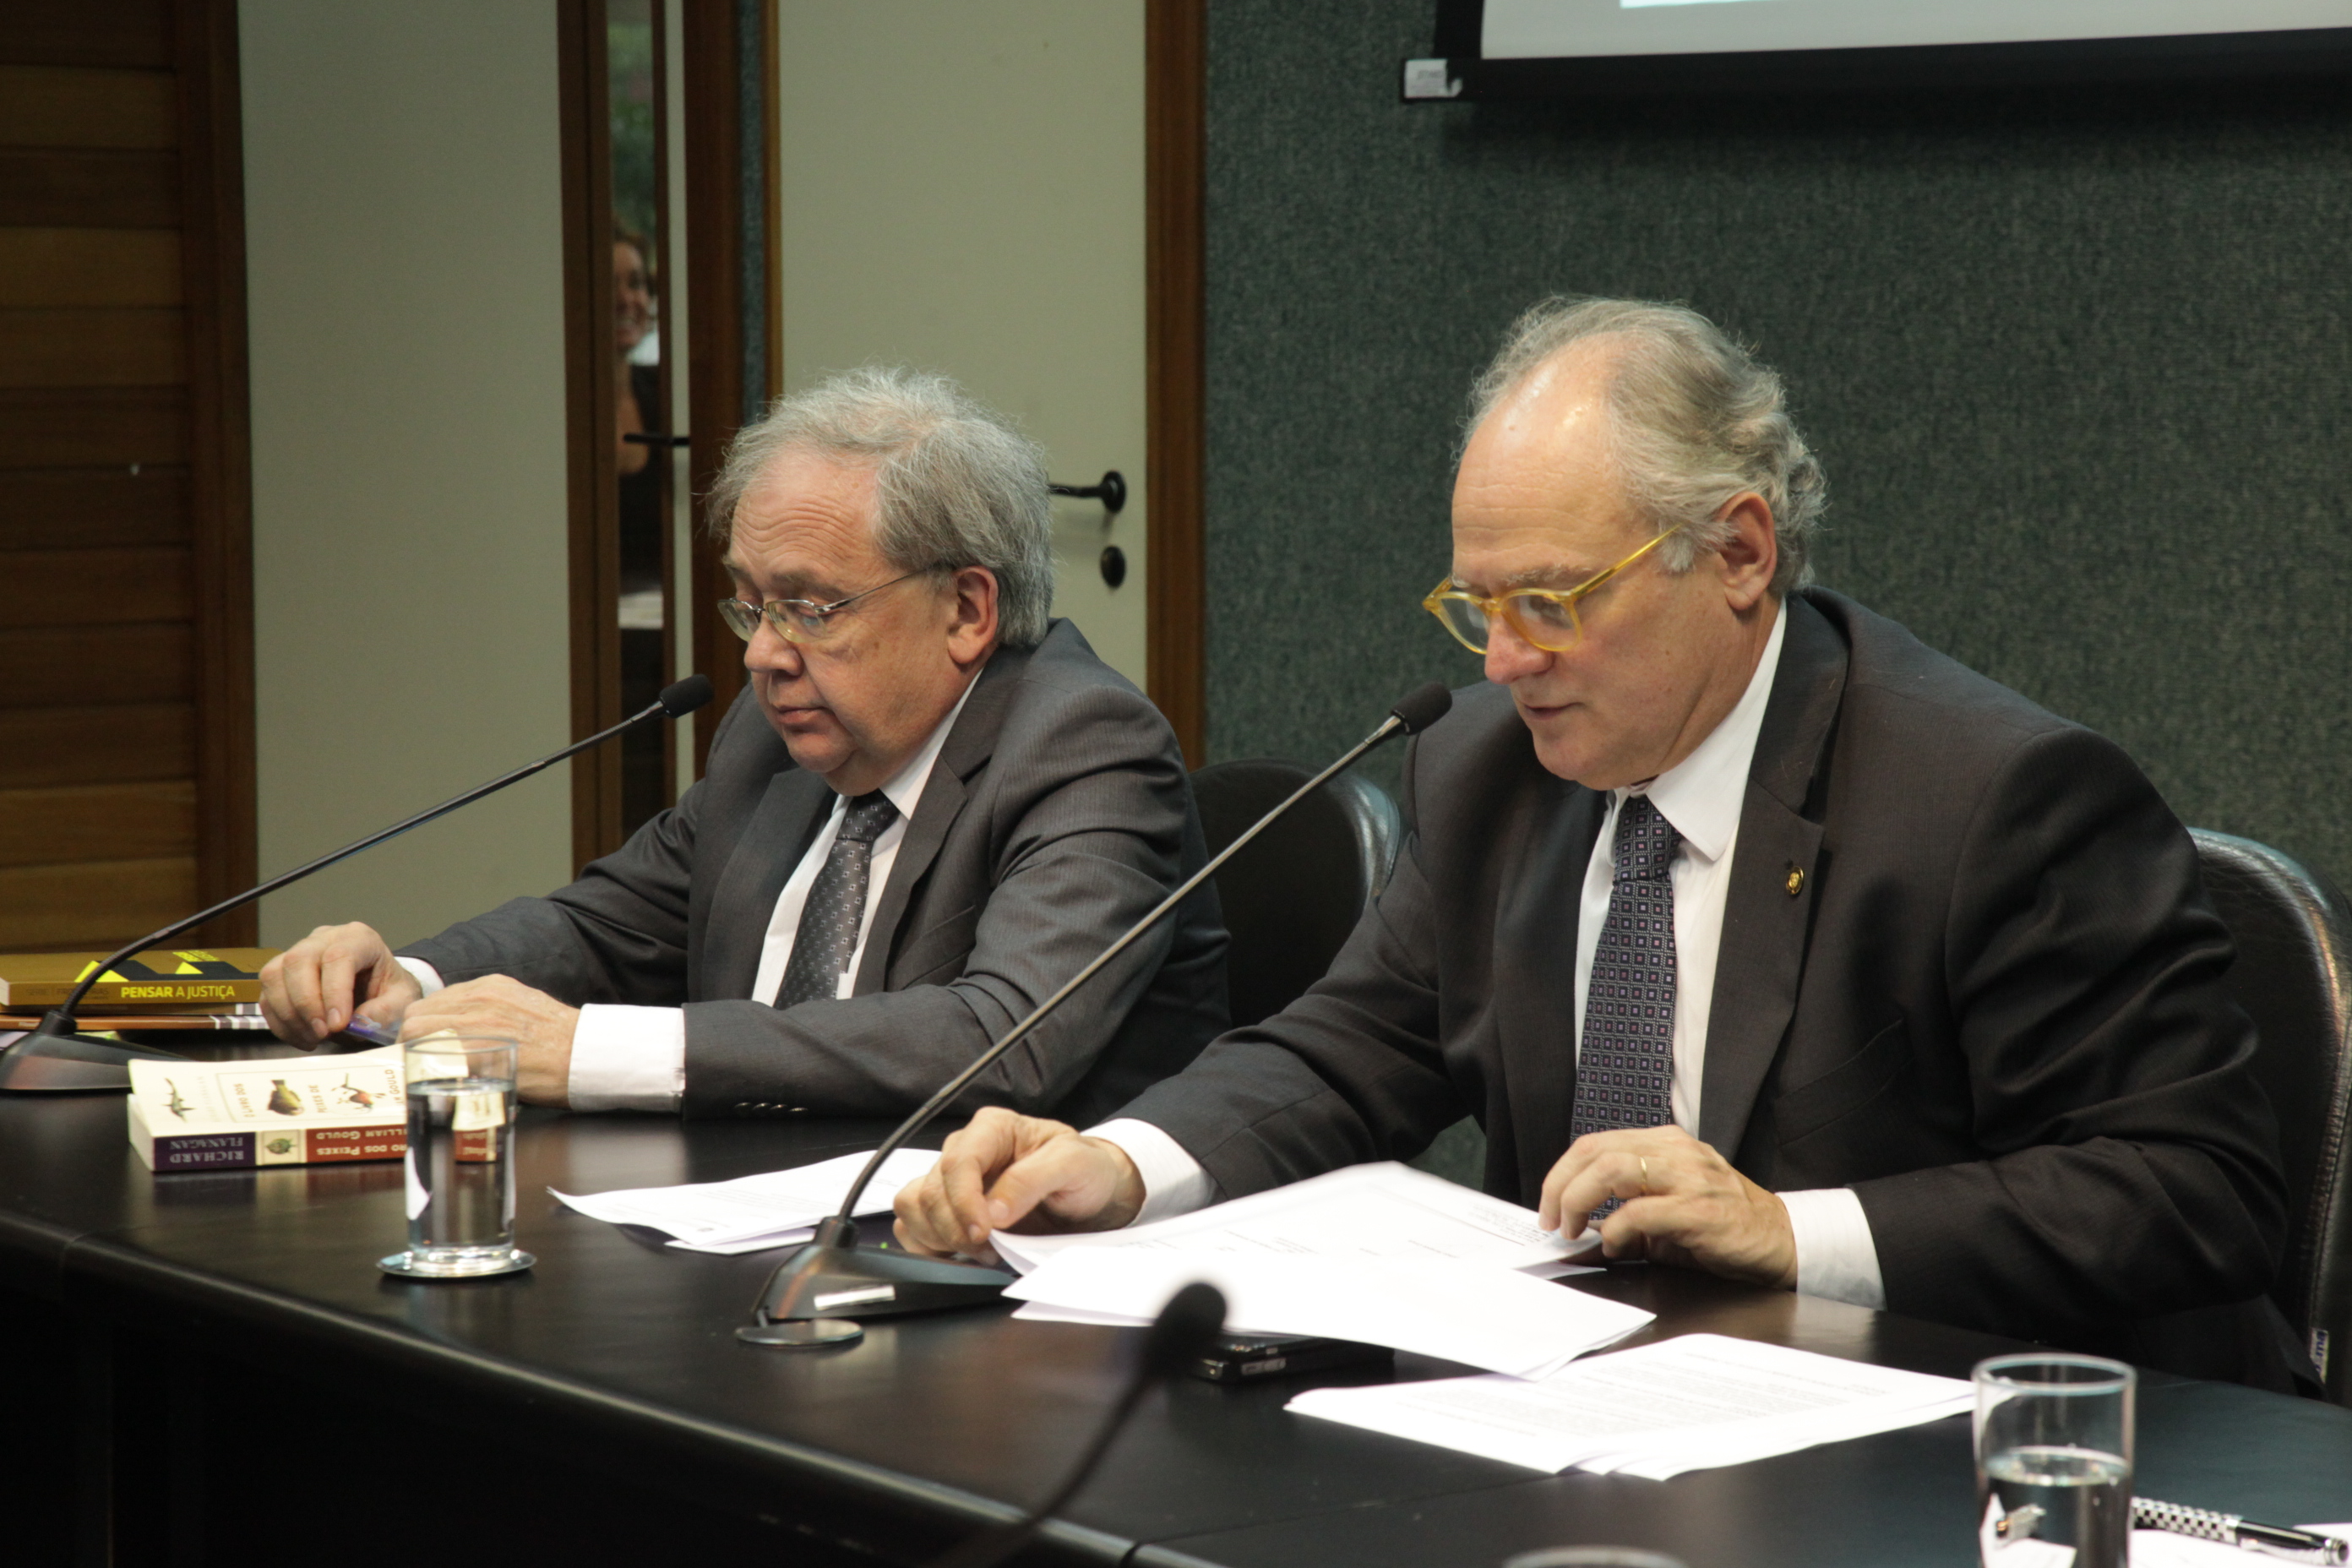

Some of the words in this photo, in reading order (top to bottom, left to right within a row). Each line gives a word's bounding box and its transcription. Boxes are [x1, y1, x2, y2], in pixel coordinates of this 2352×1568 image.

[121, 987, 173, 998] PENSAR
[175, 986, 185, 997] A
[187, 985, 235, 999] JUSTIÇA
[384, 1069, 400, 1095] GOULD
[232, 1083, 247, 1096] DOS
[308, 1085, 319, 1093] DE
[237, 1097, 253, 1113] LIVRO
[312, 1095, 328, 1113] PEIXES
[365, 1128, 408, 1137] ILLIAM
[170, 1136, 244, 1150] FLANAGAN
[363, 1144, 388, 1153] DOS
[169, 1150, 244, 1163] RICHARD
